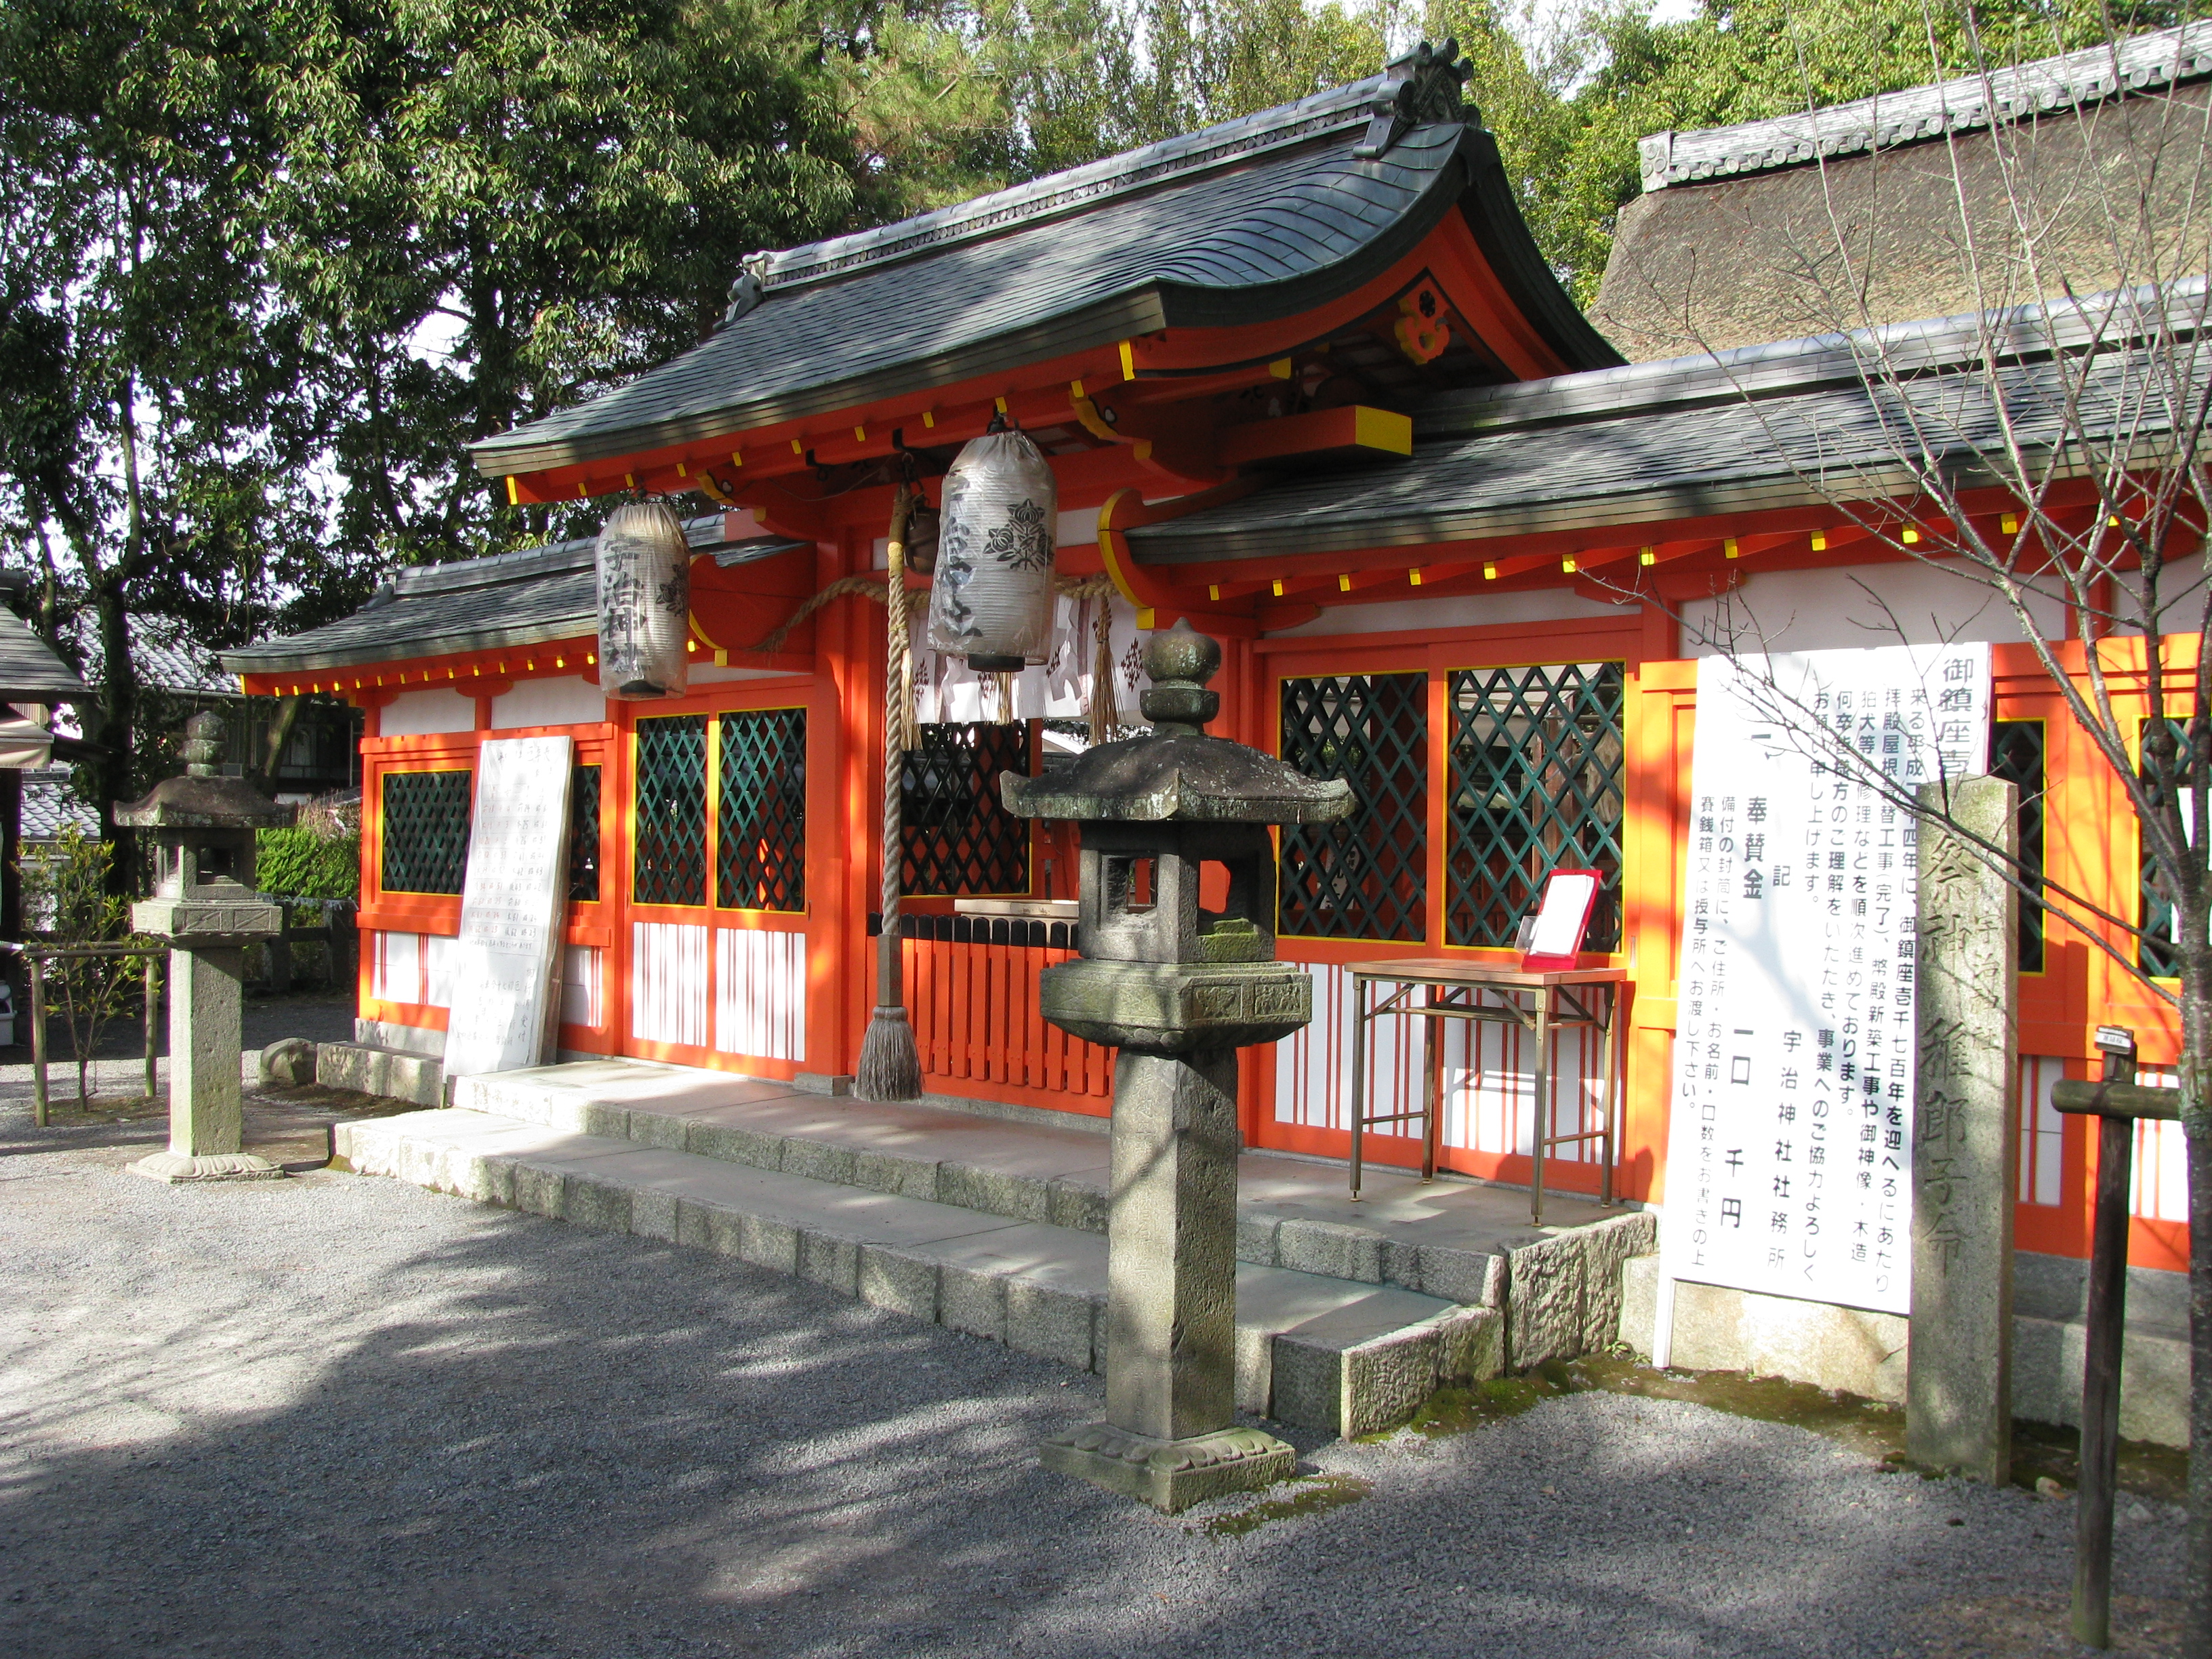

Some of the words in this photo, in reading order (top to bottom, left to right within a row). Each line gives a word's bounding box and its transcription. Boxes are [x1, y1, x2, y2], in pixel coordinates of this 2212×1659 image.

[1742, 796, 1767, 899] 奉賛金
[1773, 865, 1791, 888] 記
[1767, 1029, 1802, 1271] 宇治神社社務所
